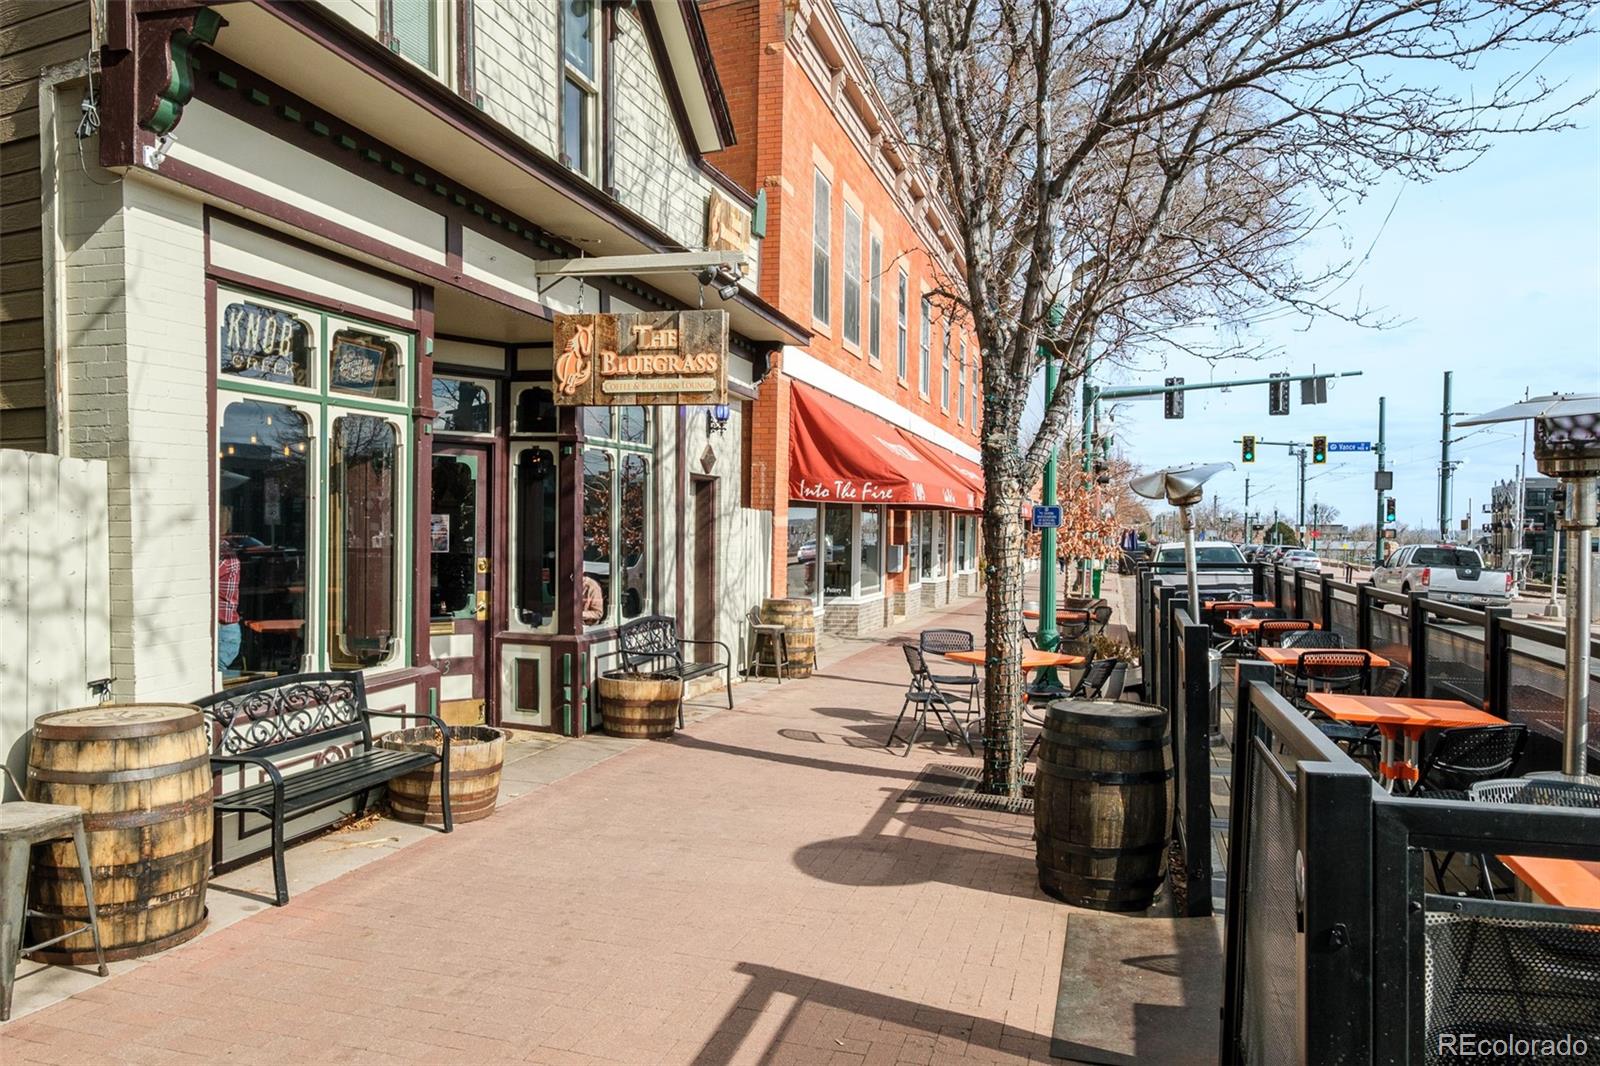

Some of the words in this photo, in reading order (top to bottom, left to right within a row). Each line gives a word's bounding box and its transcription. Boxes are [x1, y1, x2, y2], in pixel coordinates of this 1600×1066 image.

[227, 308, 293, 357] KNOB
[632, 325, 678, 350] THE
[600, 350, 718, 376] BLUEGRASS
[799, 479, 830, 497] Into
[834, 480, 857, 499] The
[861, 481, 894, 501] Fire
